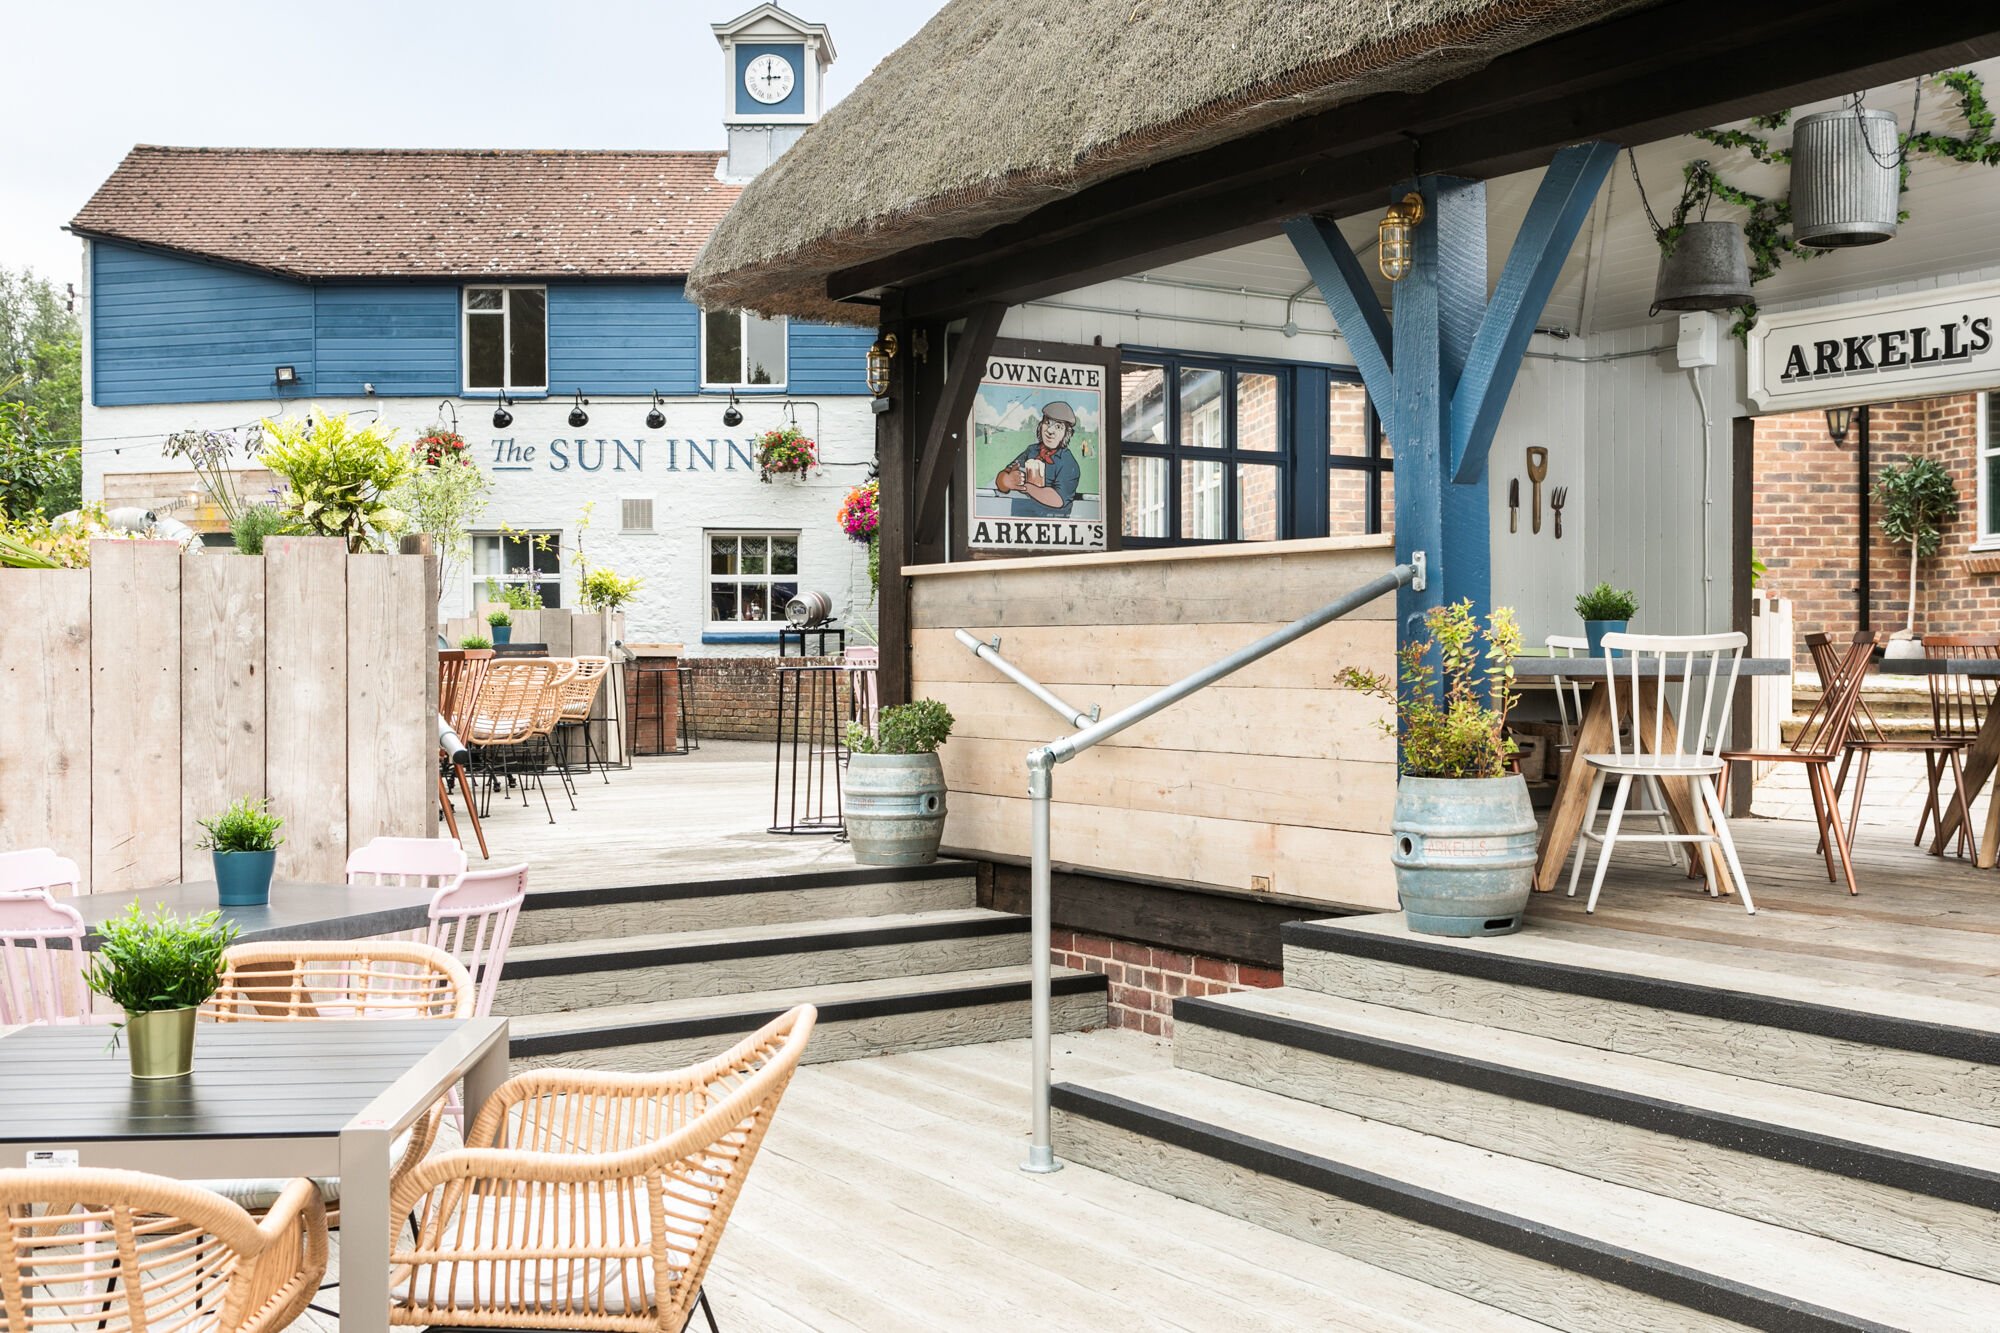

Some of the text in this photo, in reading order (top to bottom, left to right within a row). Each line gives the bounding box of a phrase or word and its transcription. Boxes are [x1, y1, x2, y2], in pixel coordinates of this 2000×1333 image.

[1780, 314, 1992, 383] ARKELL'S
[983, 362, 1100, 387] OWNGATE
[491, 438, 755, 472] The SUN INN
[972, 521, 1104, 546] ARKELL'S
[1427, 840, 1488, 857] ARKELLS
